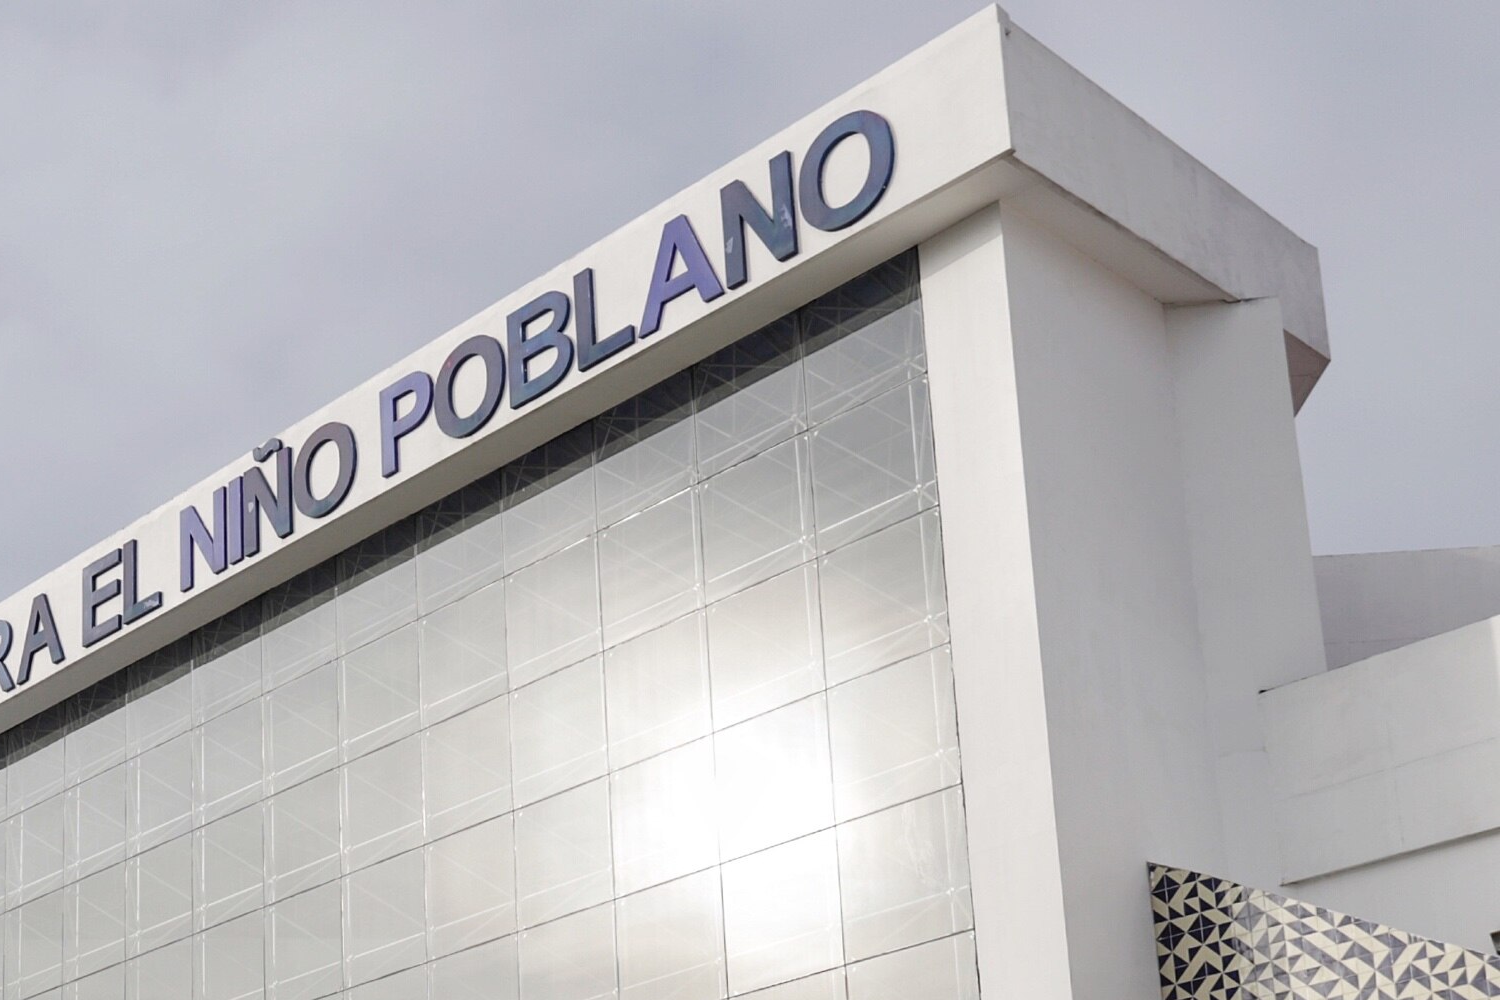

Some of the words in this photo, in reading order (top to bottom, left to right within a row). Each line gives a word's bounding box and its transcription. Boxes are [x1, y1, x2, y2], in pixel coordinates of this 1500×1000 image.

[82, 539, 162, 648] EL
[179, 421, 358, 592] NIÑO
[379, 109, 896, 478] POBLANO
